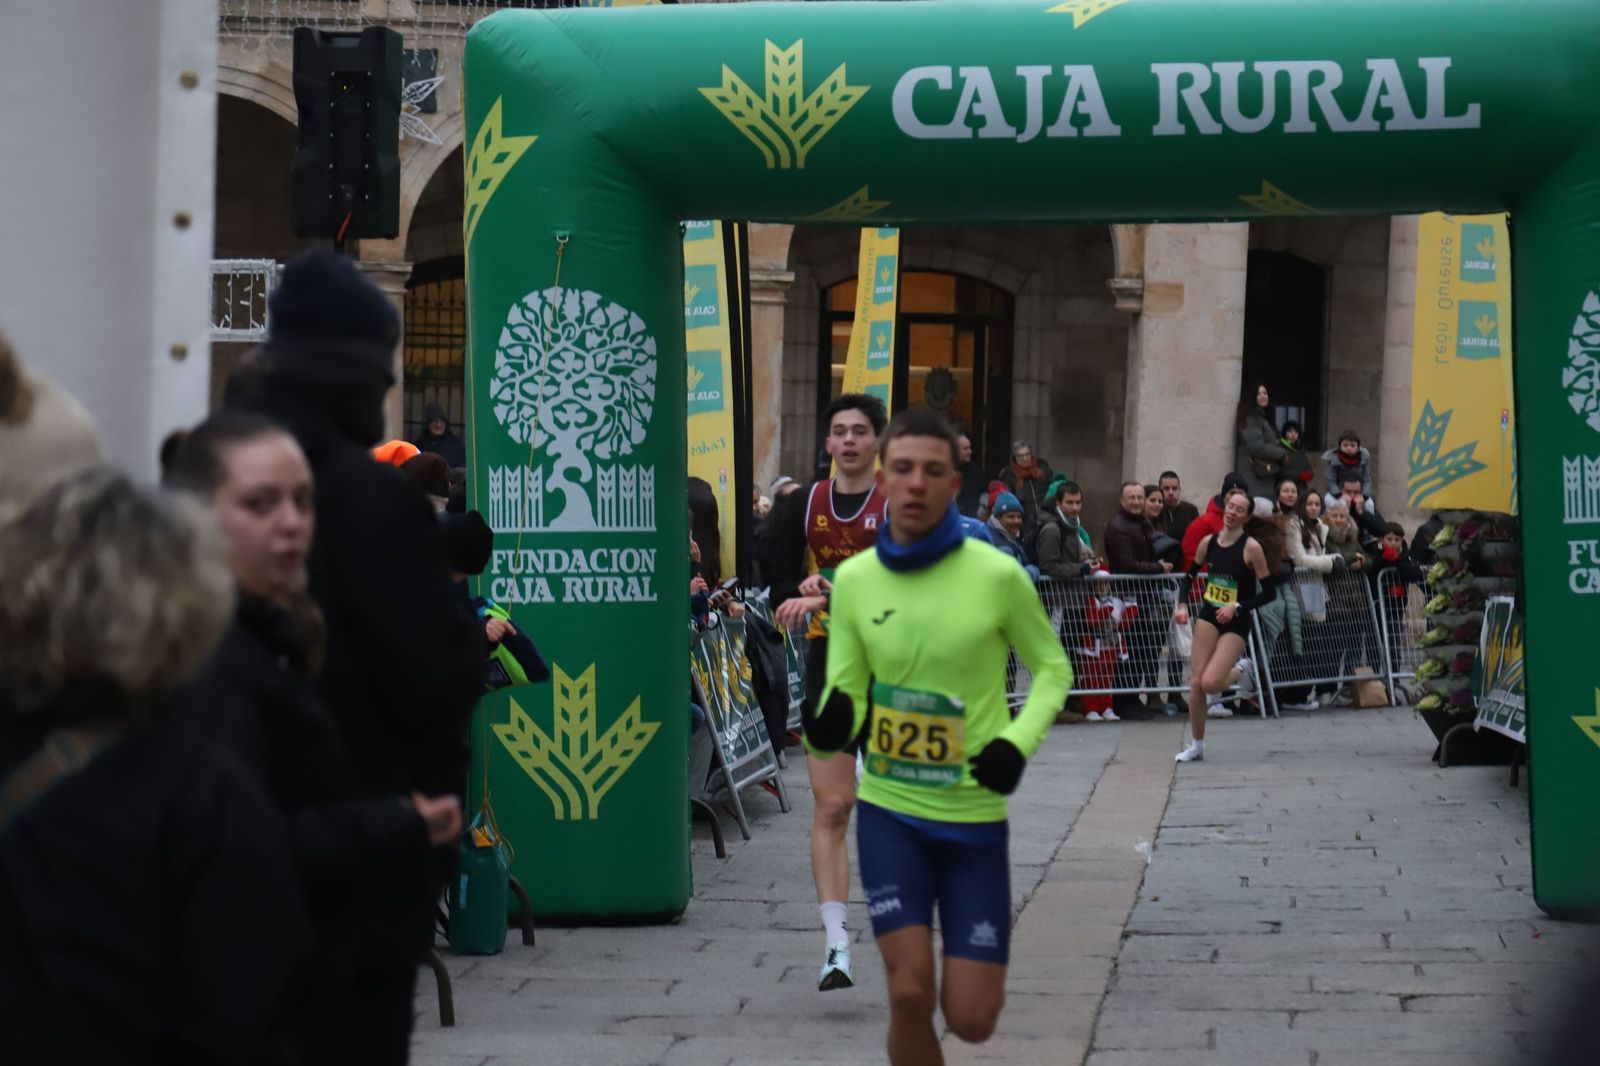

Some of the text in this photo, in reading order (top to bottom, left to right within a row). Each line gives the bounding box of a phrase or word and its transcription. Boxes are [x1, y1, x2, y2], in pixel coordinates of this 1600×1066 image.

[892, 57, 1481, 143] CAJA RURAL
[491, 548, 657, 574] FUNDACION
[491, 576, 658, 604] CAJA RURAL
[1209, 585, 1230, 602] 175
[877, 716, 949, 762] 625
